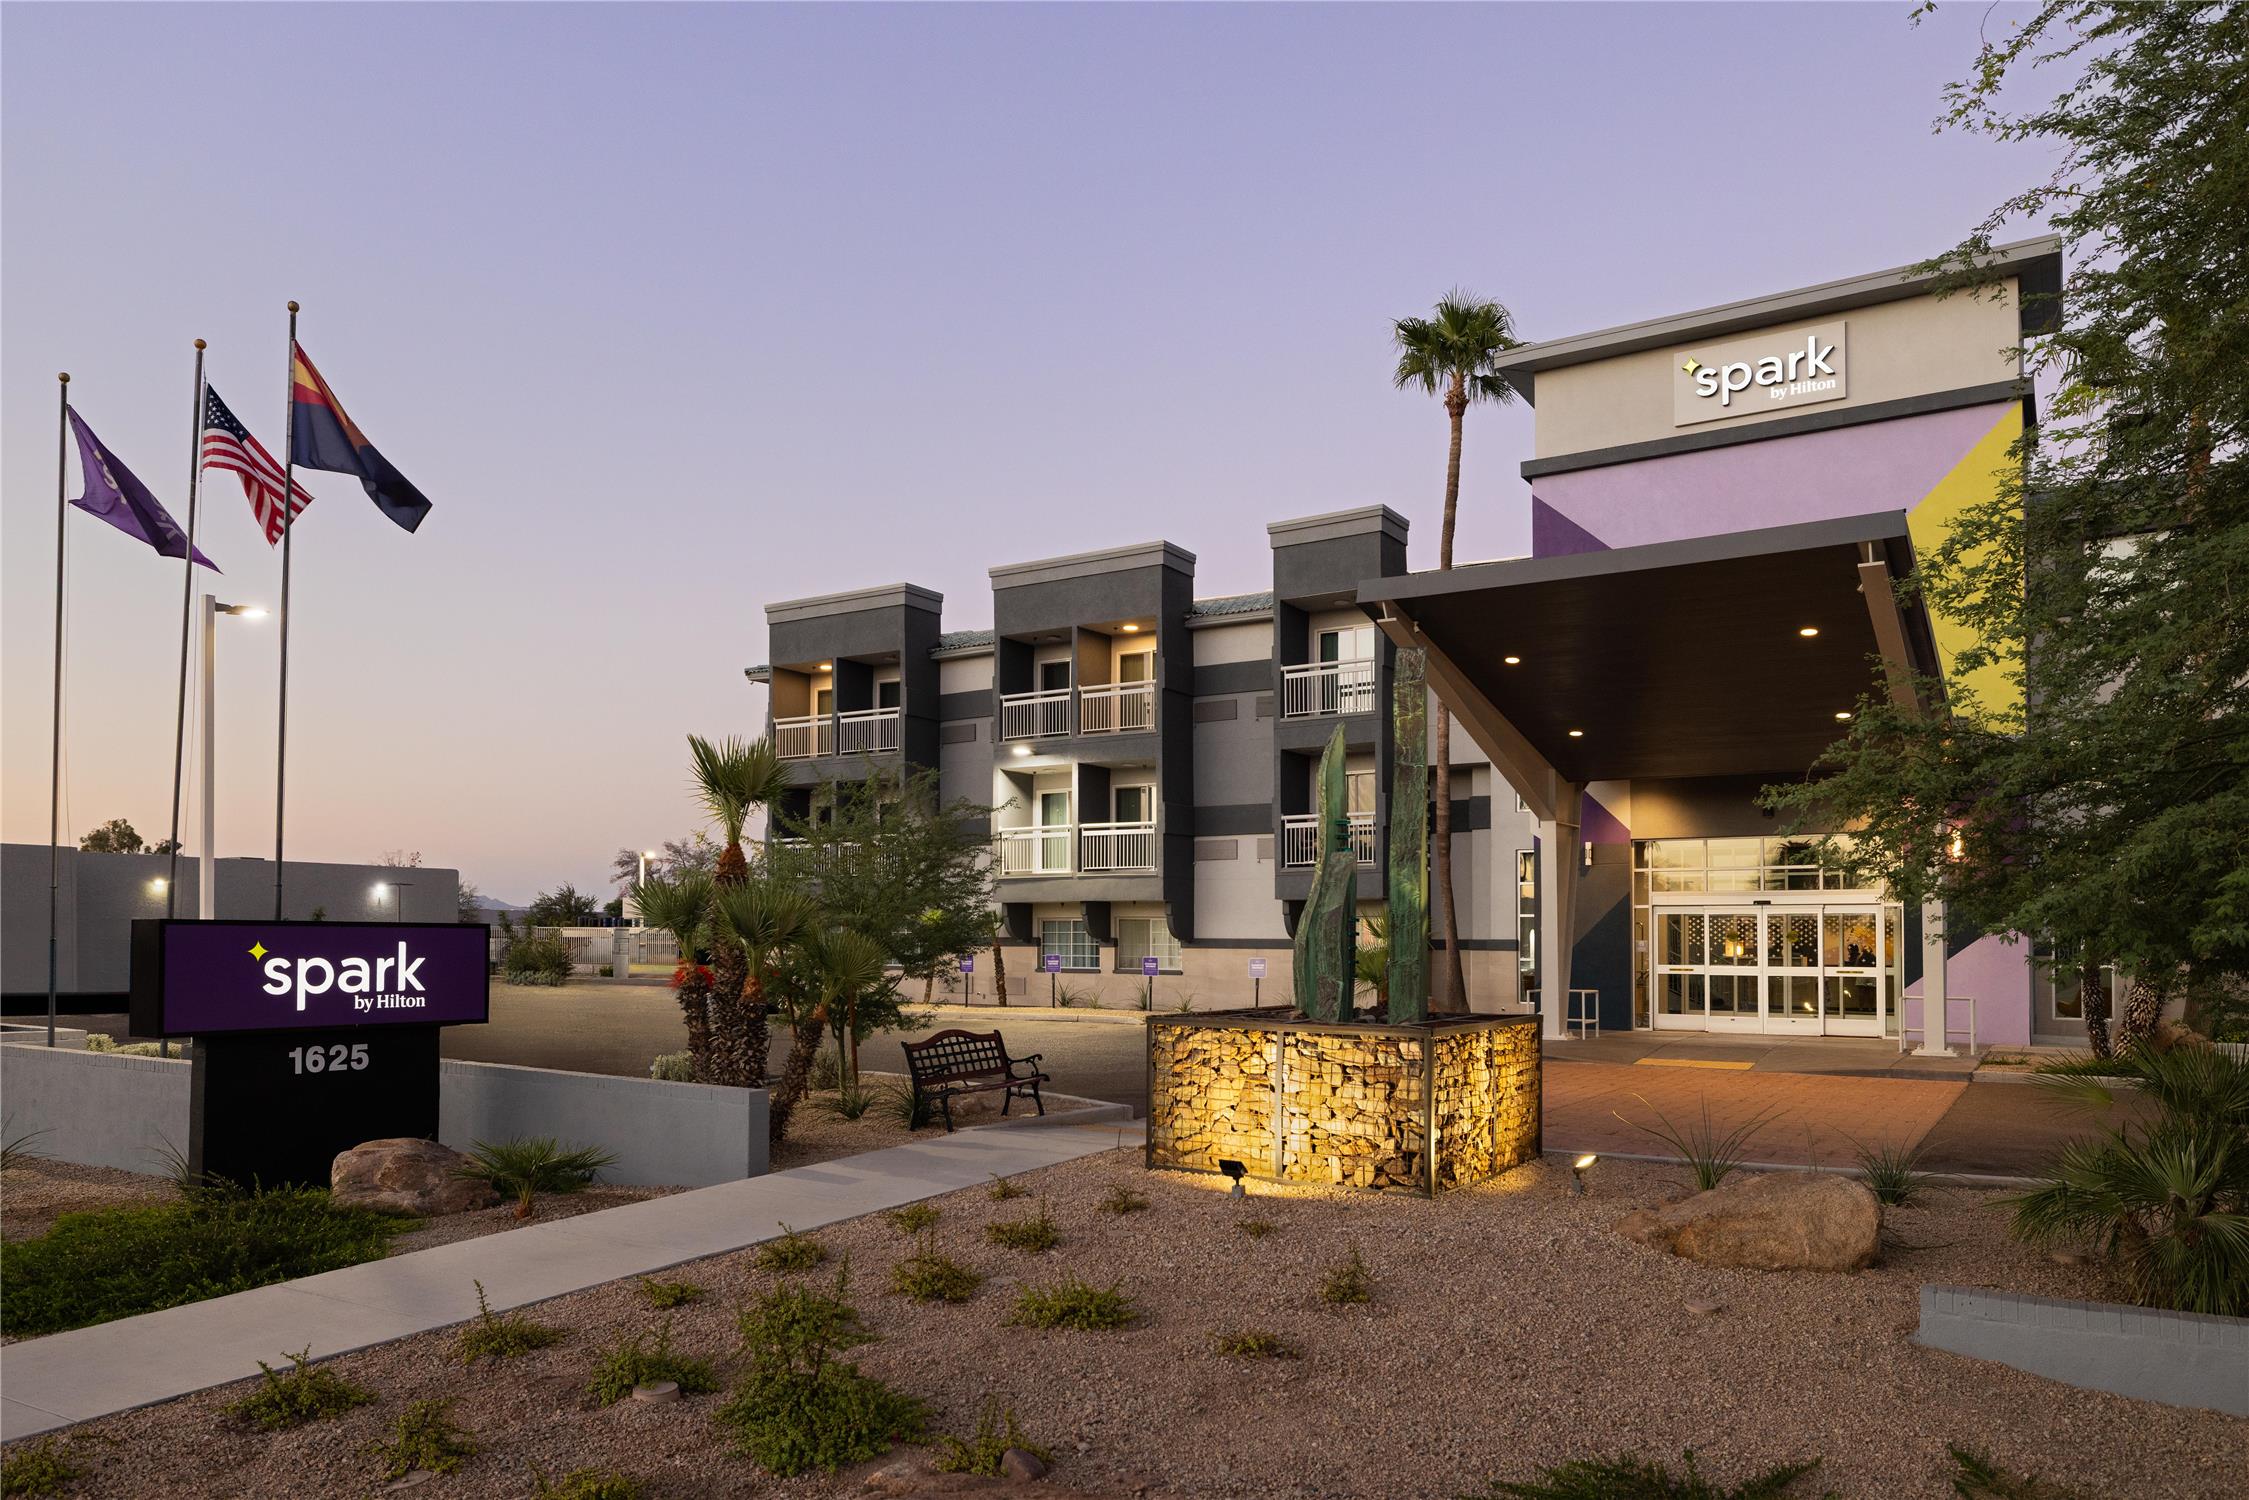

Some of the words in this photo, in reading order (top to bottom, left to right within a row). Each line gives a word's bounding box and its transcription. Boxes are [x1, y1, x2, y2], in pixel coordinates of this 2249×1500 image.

[1695, 335, 1836, 407] spark
[1770, 386, 1788, 401] by
[1790, 379, 1836, 396] Hilton
[262, 941, 426, 1011] spark
[354, 995, 373, 1013] by
[376, 993, 426, 1009] Hilton
[288, 1043, 370, 1075] 1625
